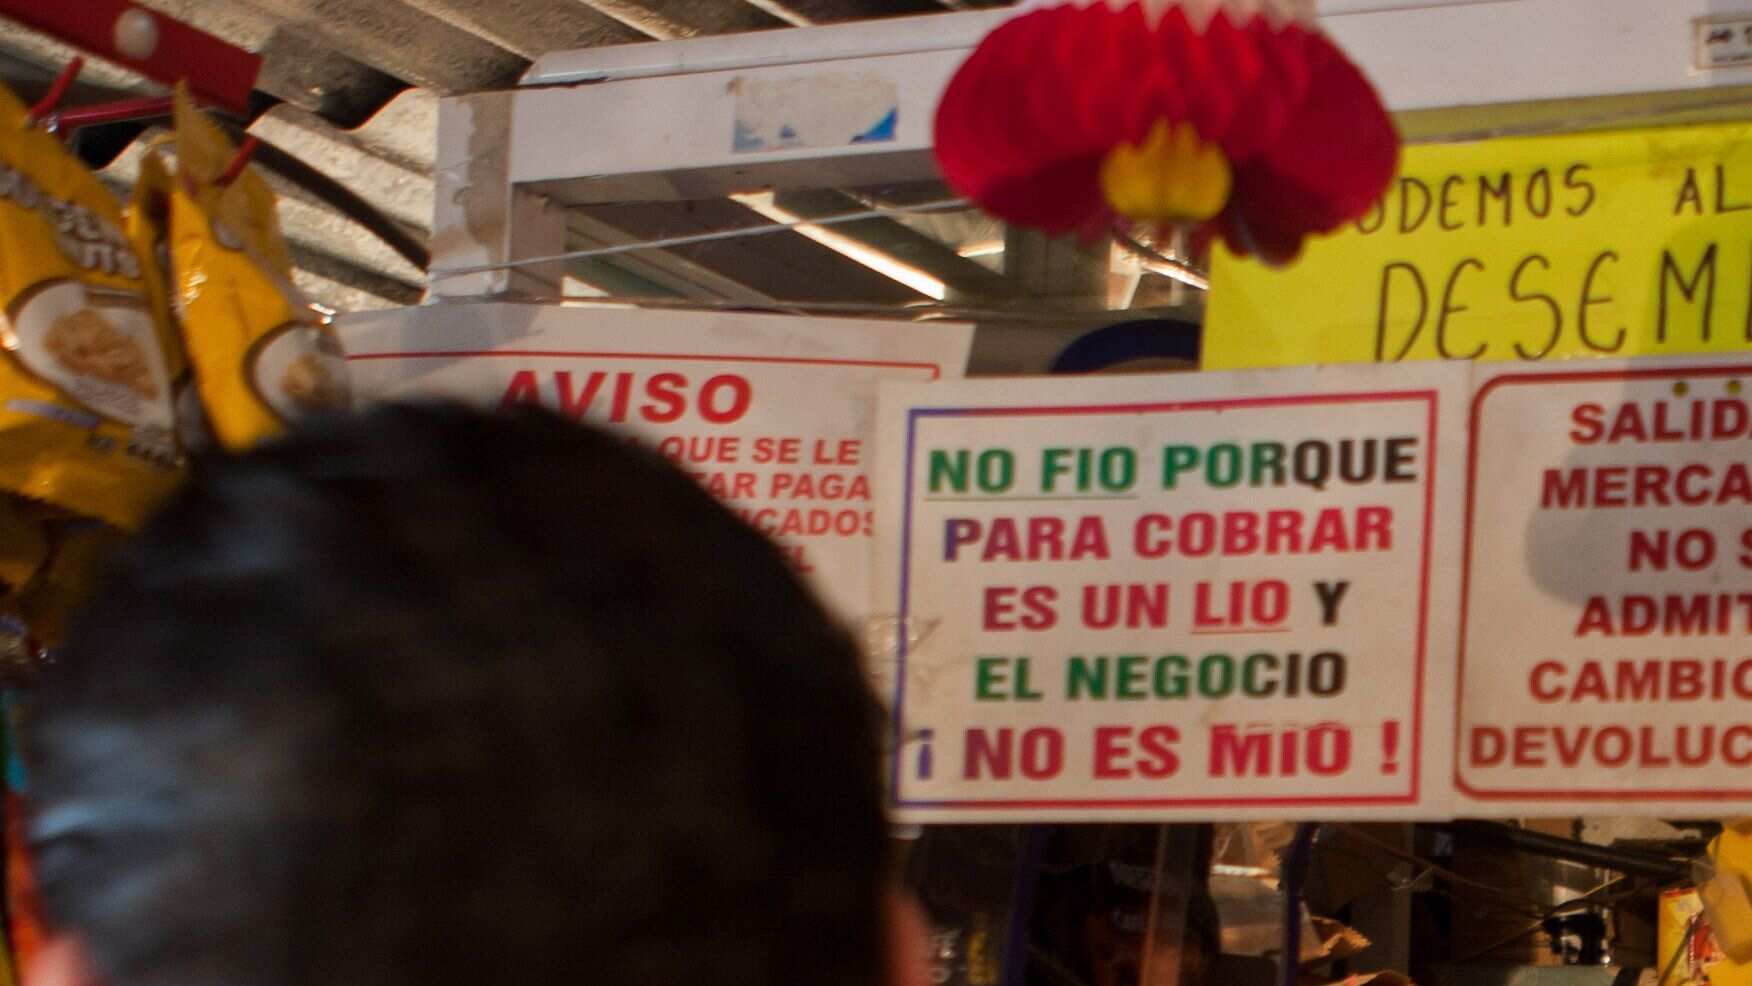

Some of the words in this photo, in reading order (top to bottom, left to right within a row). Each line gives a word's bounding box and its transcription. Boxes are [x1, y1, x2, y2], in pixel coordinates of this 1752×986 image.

[659, 436, 741, 465] QUE
[752, 437, 802, 465] SE
[812, 439, 862, 465] LE
[927, 447, 1016, 493] NO
[1040, 445, 1138, 492] FIO
[1162, 437, 1419, 491] PORQUE
[943, 515, 1110, 563] PARA
[1132, 505, 1395, 559] COBRAR
[1628, 530, 1716, 572] NO
[981, 585, 1058, 632] ES
[1081, 583, 1169, 631] UN
[1193, 579, 1292, 628] LIO
[1313, 580, 1351, 627] Y
[974, 656, 1043, 701] EL
[1066, 650, 1347, 701] NEGOCIO
[963, 726, 1065, 781] NO
[1092, 724, 1181, 780] ES
